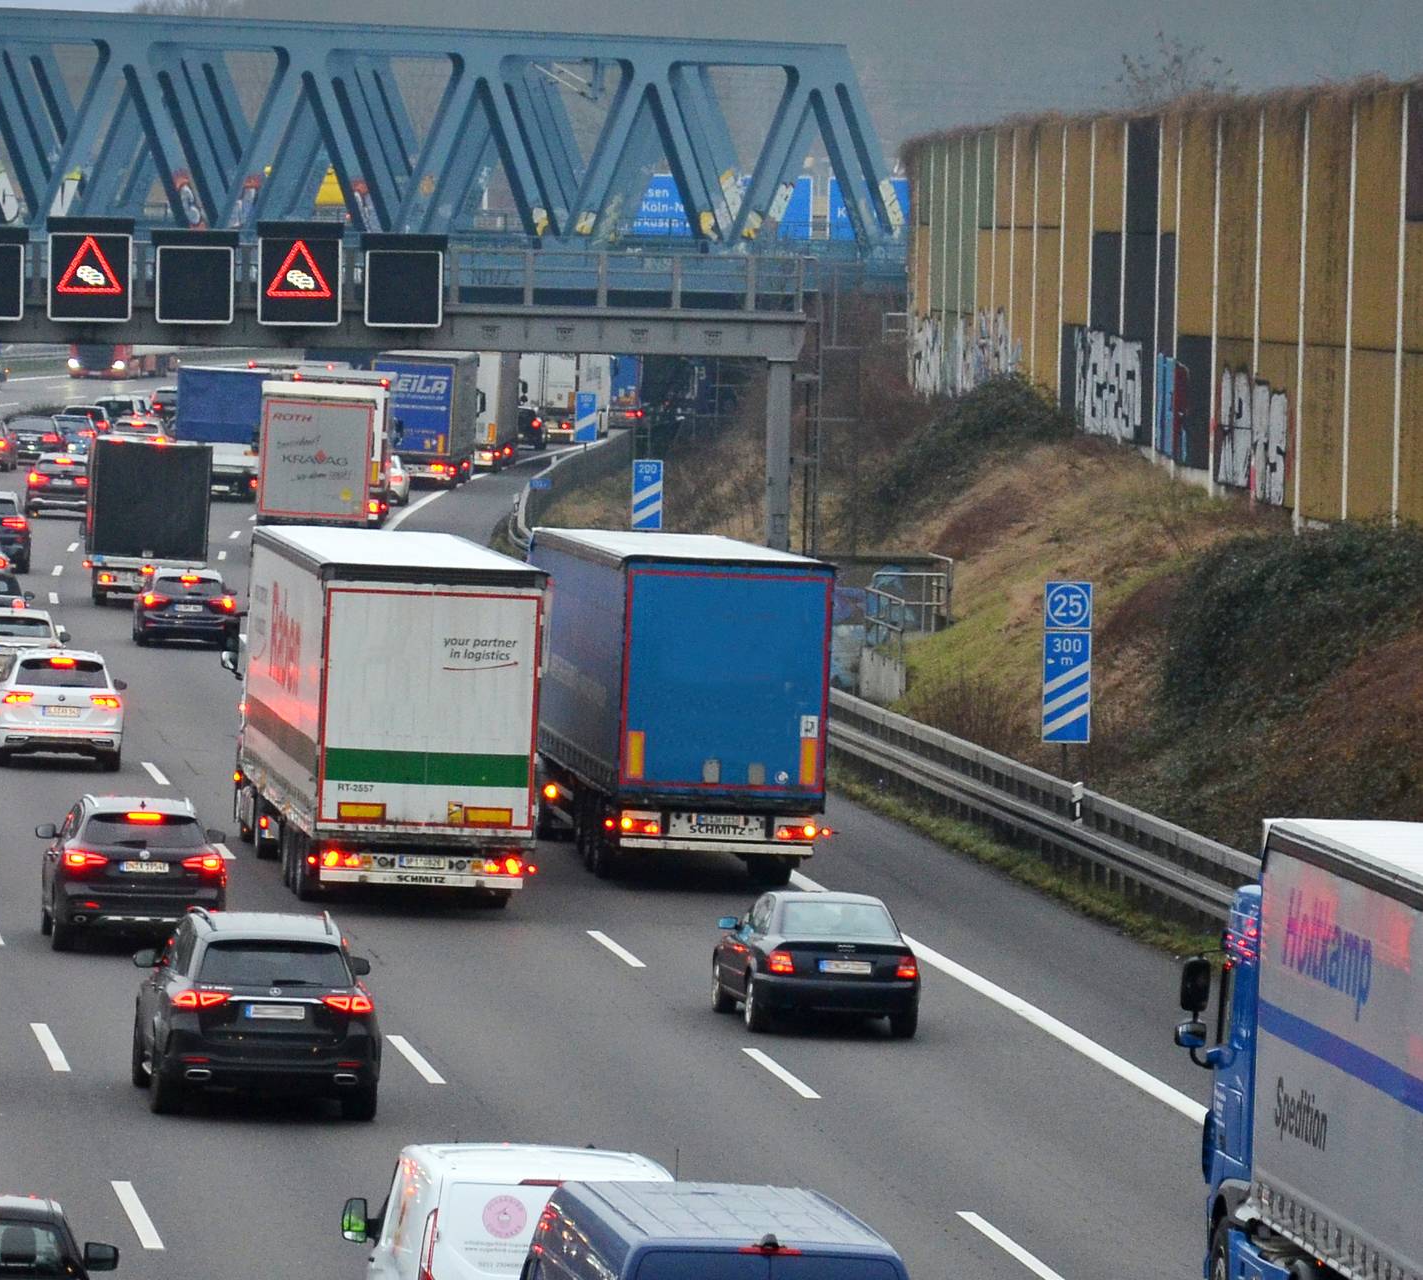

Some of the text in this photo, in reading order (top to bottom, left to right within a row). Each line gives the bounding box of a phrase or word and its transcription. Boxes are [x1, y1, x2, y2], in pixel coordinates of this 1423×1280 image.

[272, 412, 313, 422] ROTH
[638, 464, 657, 474] 200
[1053, 594, 1083, 617] 25
[444, 637, 517, 648] your partner
[1053, 637, 1082, 653] 300
[449, 648, 511, 661] in logistics
[1060, 656, 1074, 665] m
[337, 783, 375, 793] RT-2557
[690, 823, 746, 836] SCHMITZ
[396, 874, 446, 884] SCHMITZ
[1282, 886, 1373, 1022] Holtkamp
[1273, 1075, 1328, 1152] Spedition
